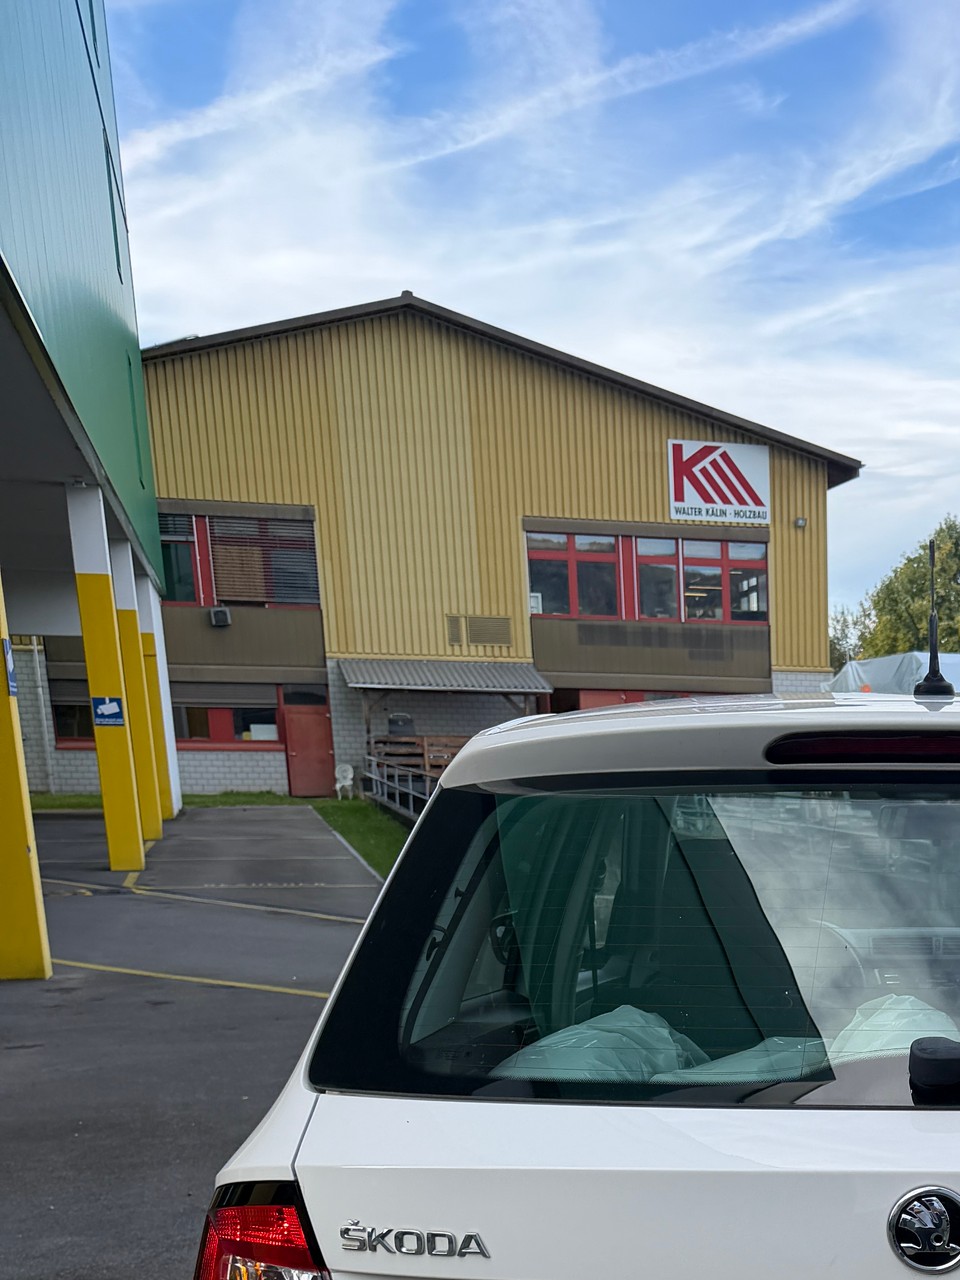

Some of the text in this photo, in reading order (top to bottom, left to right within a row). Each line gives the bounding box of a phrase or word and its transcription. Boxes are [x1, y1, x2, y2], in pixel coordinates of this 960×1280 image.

[674, 506, 767, 519] WALTER KÄLIN HOLZBAU
[339, 1218, 491, 1259] ŠKODA
